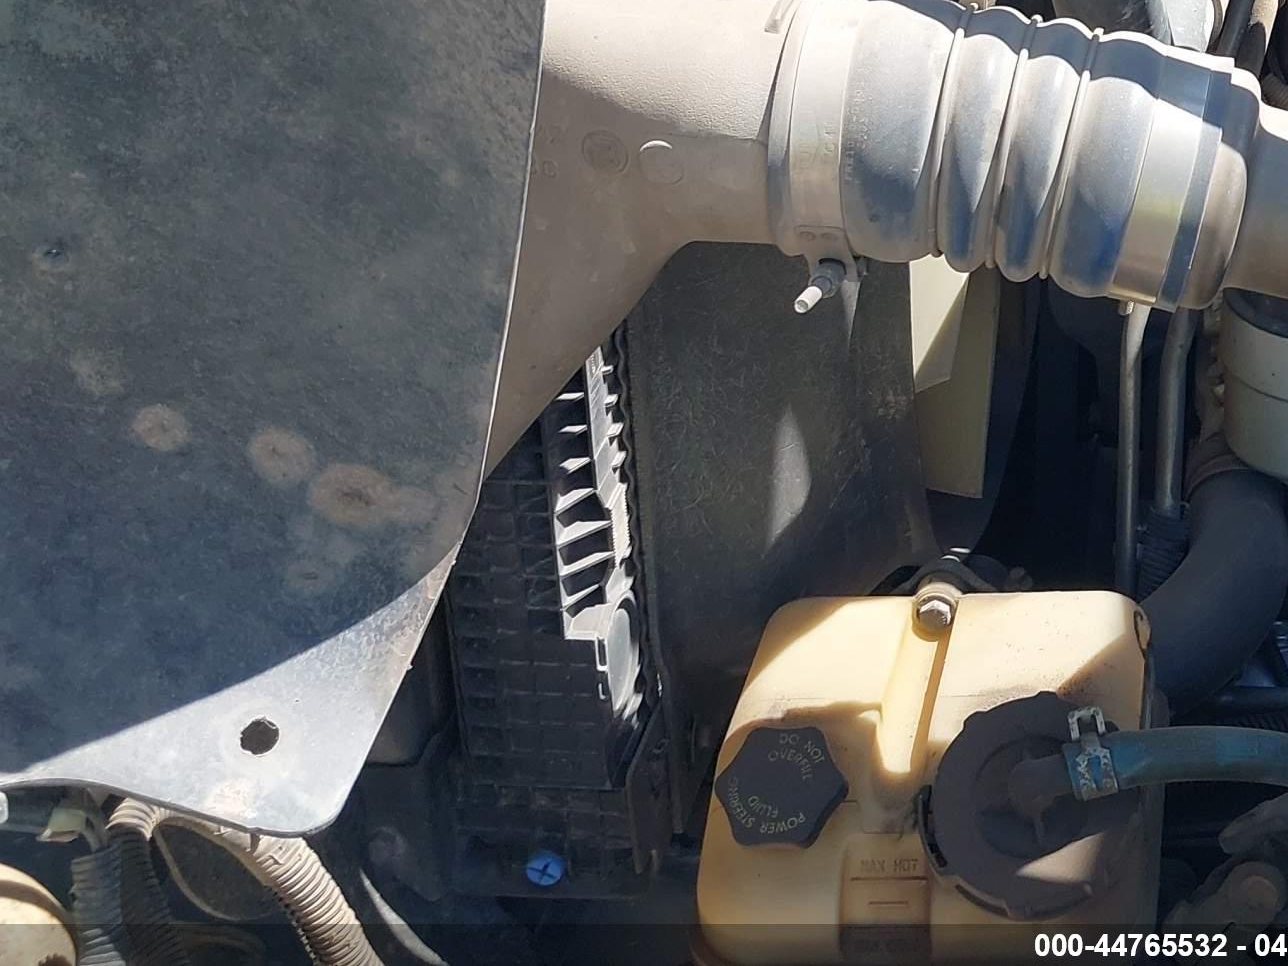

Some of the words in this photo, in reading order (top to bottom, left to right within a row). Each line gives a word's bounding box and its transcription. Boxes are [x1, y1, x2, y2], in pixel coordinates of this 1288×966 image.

[779, 733, 800, 745] DO
[804, 740, 825, 763] NOT
[767, 748, 814, 781] OVERFILL
[728, 776, 756, 828] STEERING
[747, 795, 778, 818] FLUID
[760, 812, 807, 834] POWER
[860, 859, 887, 873] MAX
[893, 858, 919, 873] HOT
